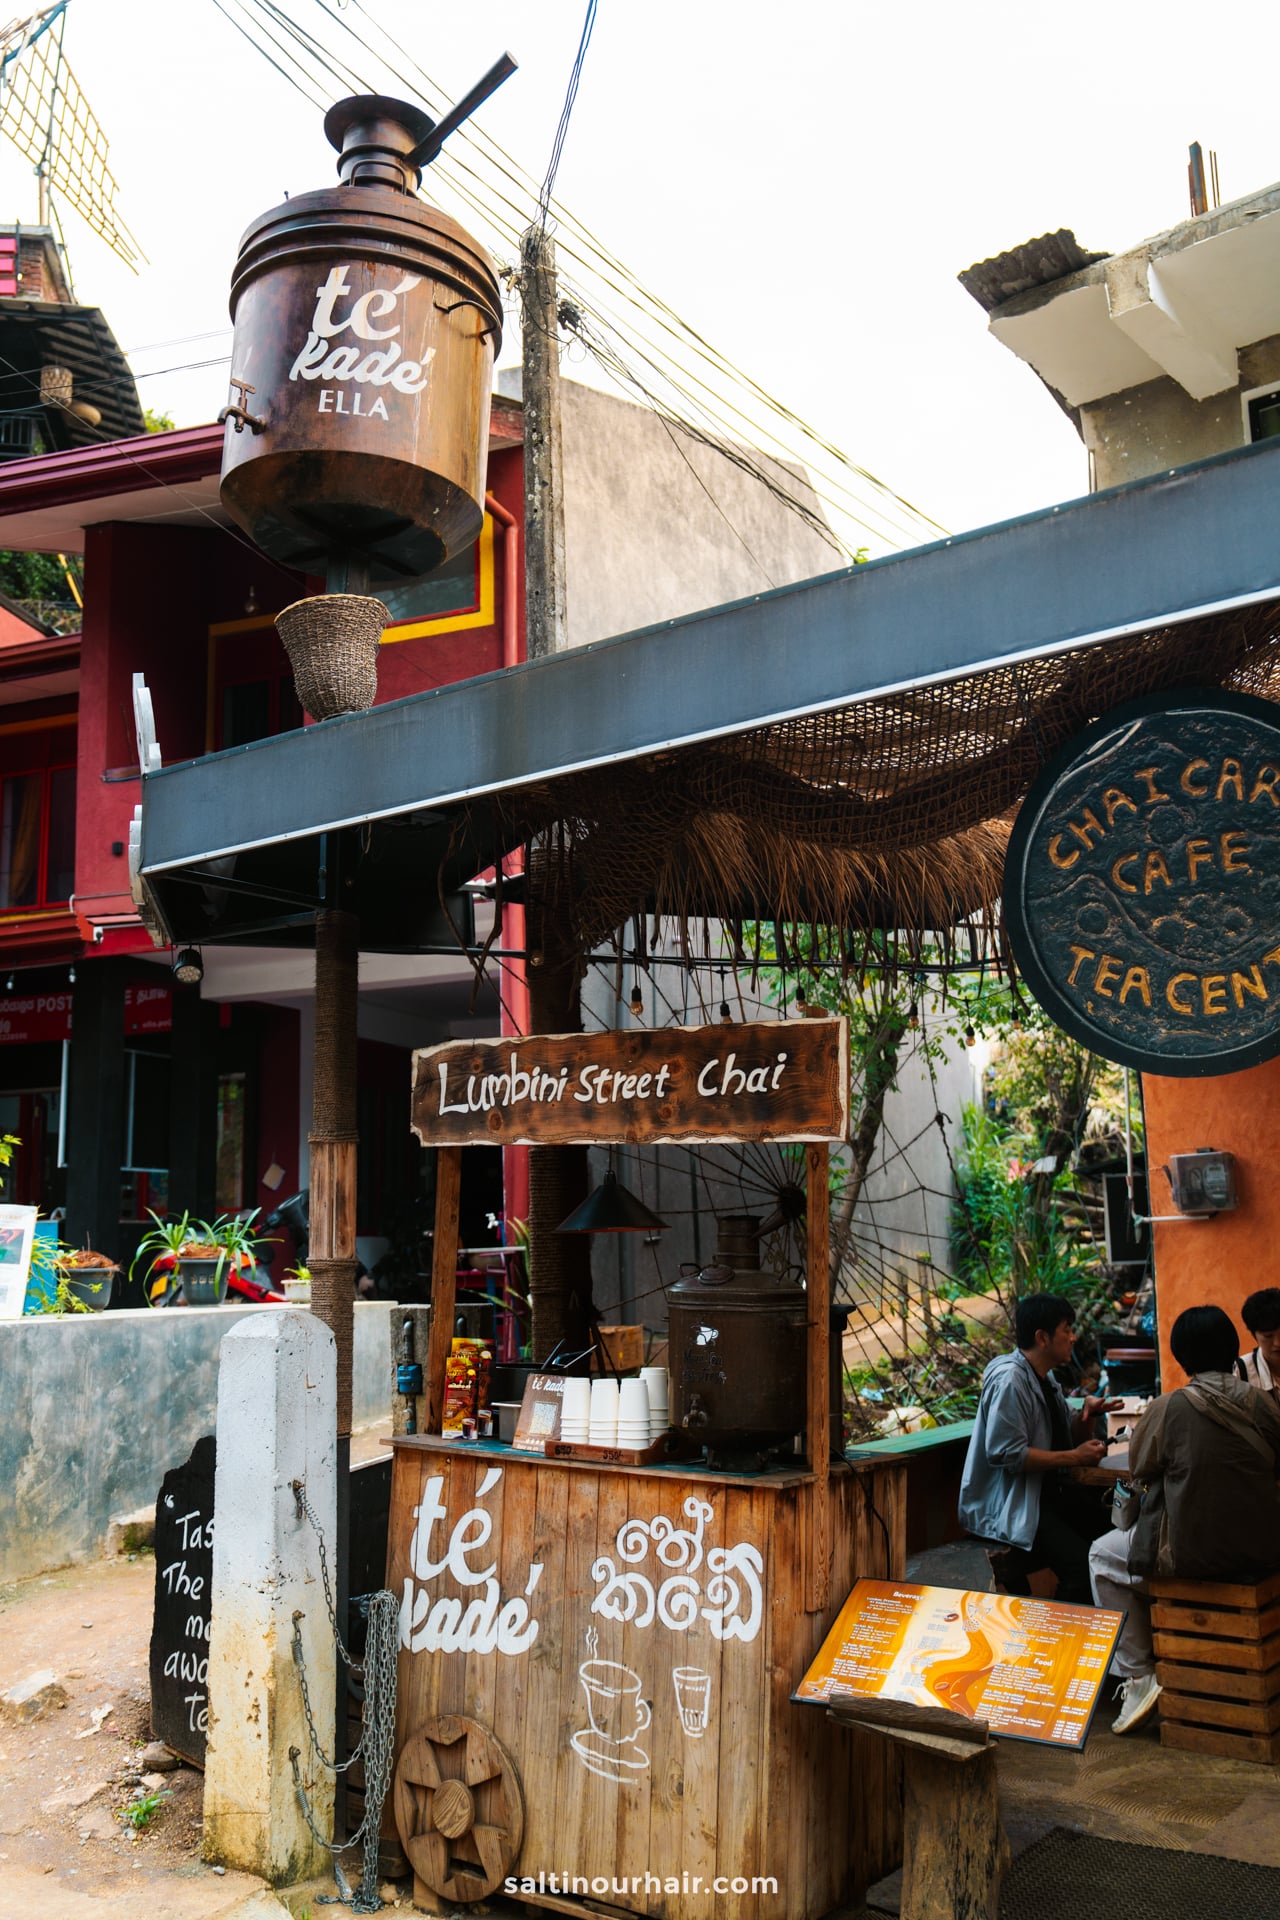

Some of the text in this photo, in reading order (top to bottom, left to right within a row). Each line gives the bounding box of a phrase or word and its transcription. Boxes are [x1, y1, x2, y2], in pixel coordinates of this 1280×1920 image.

[318, 389, 389, 421] ELLA
[1048, 767, 1170, 869] CHAI
[1111, 832, 1249, 896] CAFE
[37, 995, 73, 1013] POST
[1068, 944, 1151, 1007] TEA
[438, 1052, 789, 1116] Lumbini Street Chai
[409, 1467, 502, 1586] té
[162, 1560, 204, 1600] The
[1033, 1657, 1054, 1667] Food
